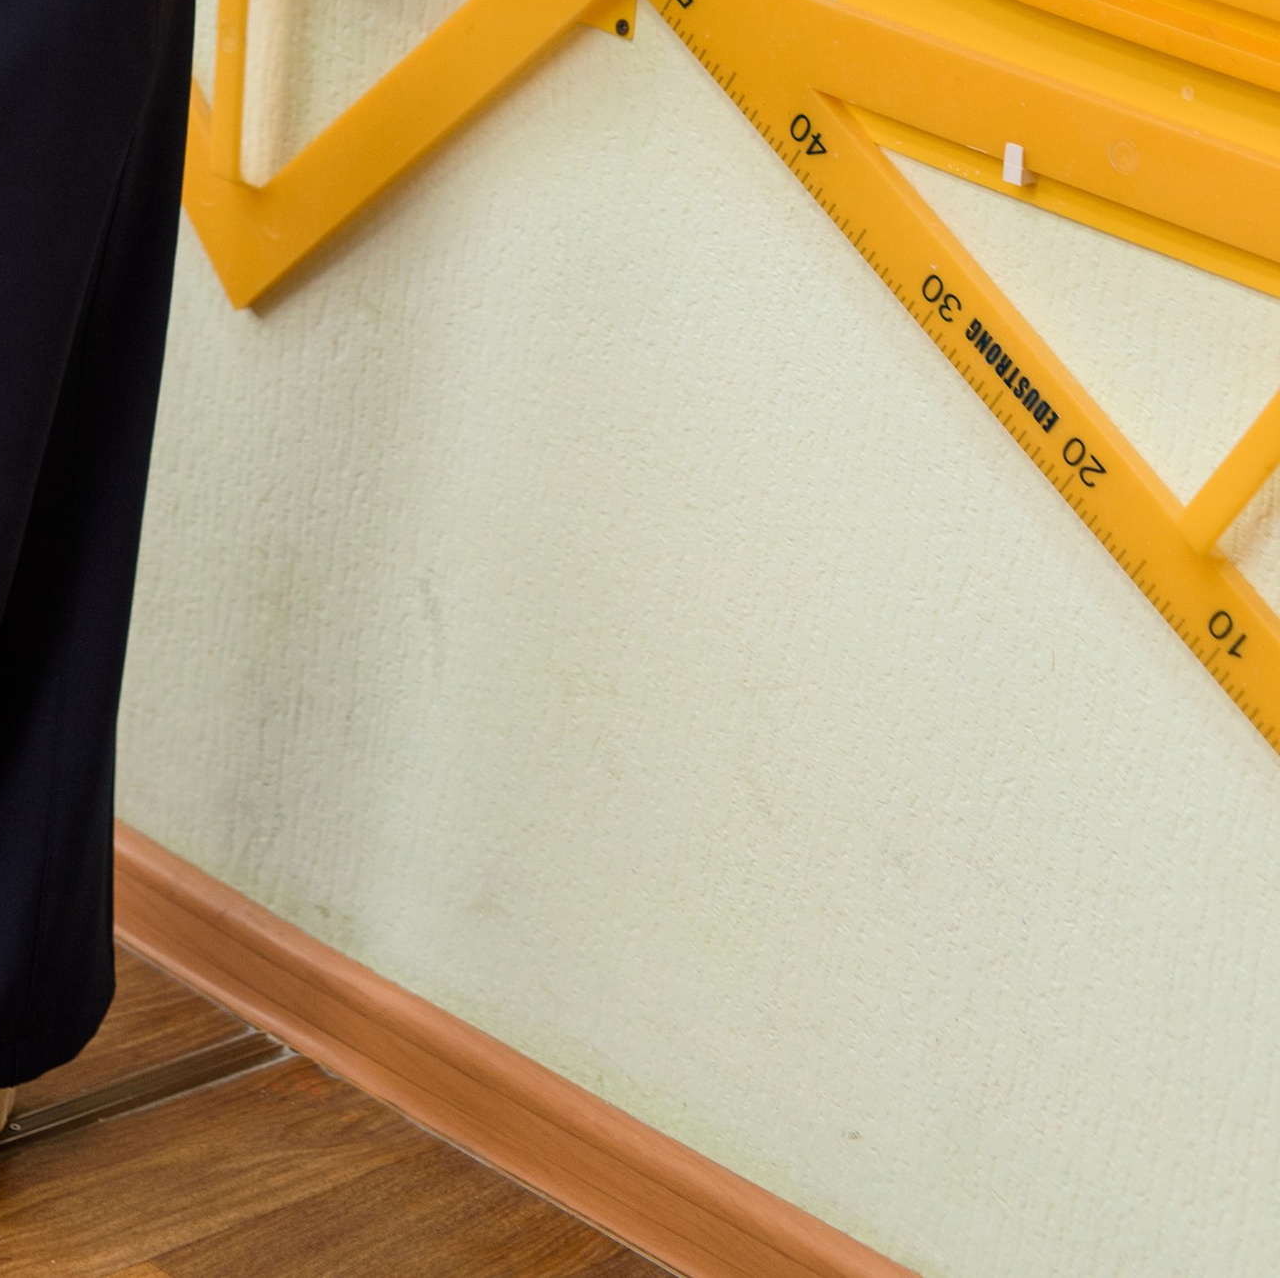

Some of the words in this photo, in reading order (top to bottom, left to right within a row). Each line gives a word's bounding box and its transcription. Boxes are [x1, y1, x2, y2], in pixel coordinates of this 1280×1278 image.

[790, 114, 827, 156] 40
[921, 274, 962, 323] 30
[965, 318, 1060, 434] EDUSTRONG
[1062, 437, 1108, 488] 20
[1208, 610, 1247, 659] 10
